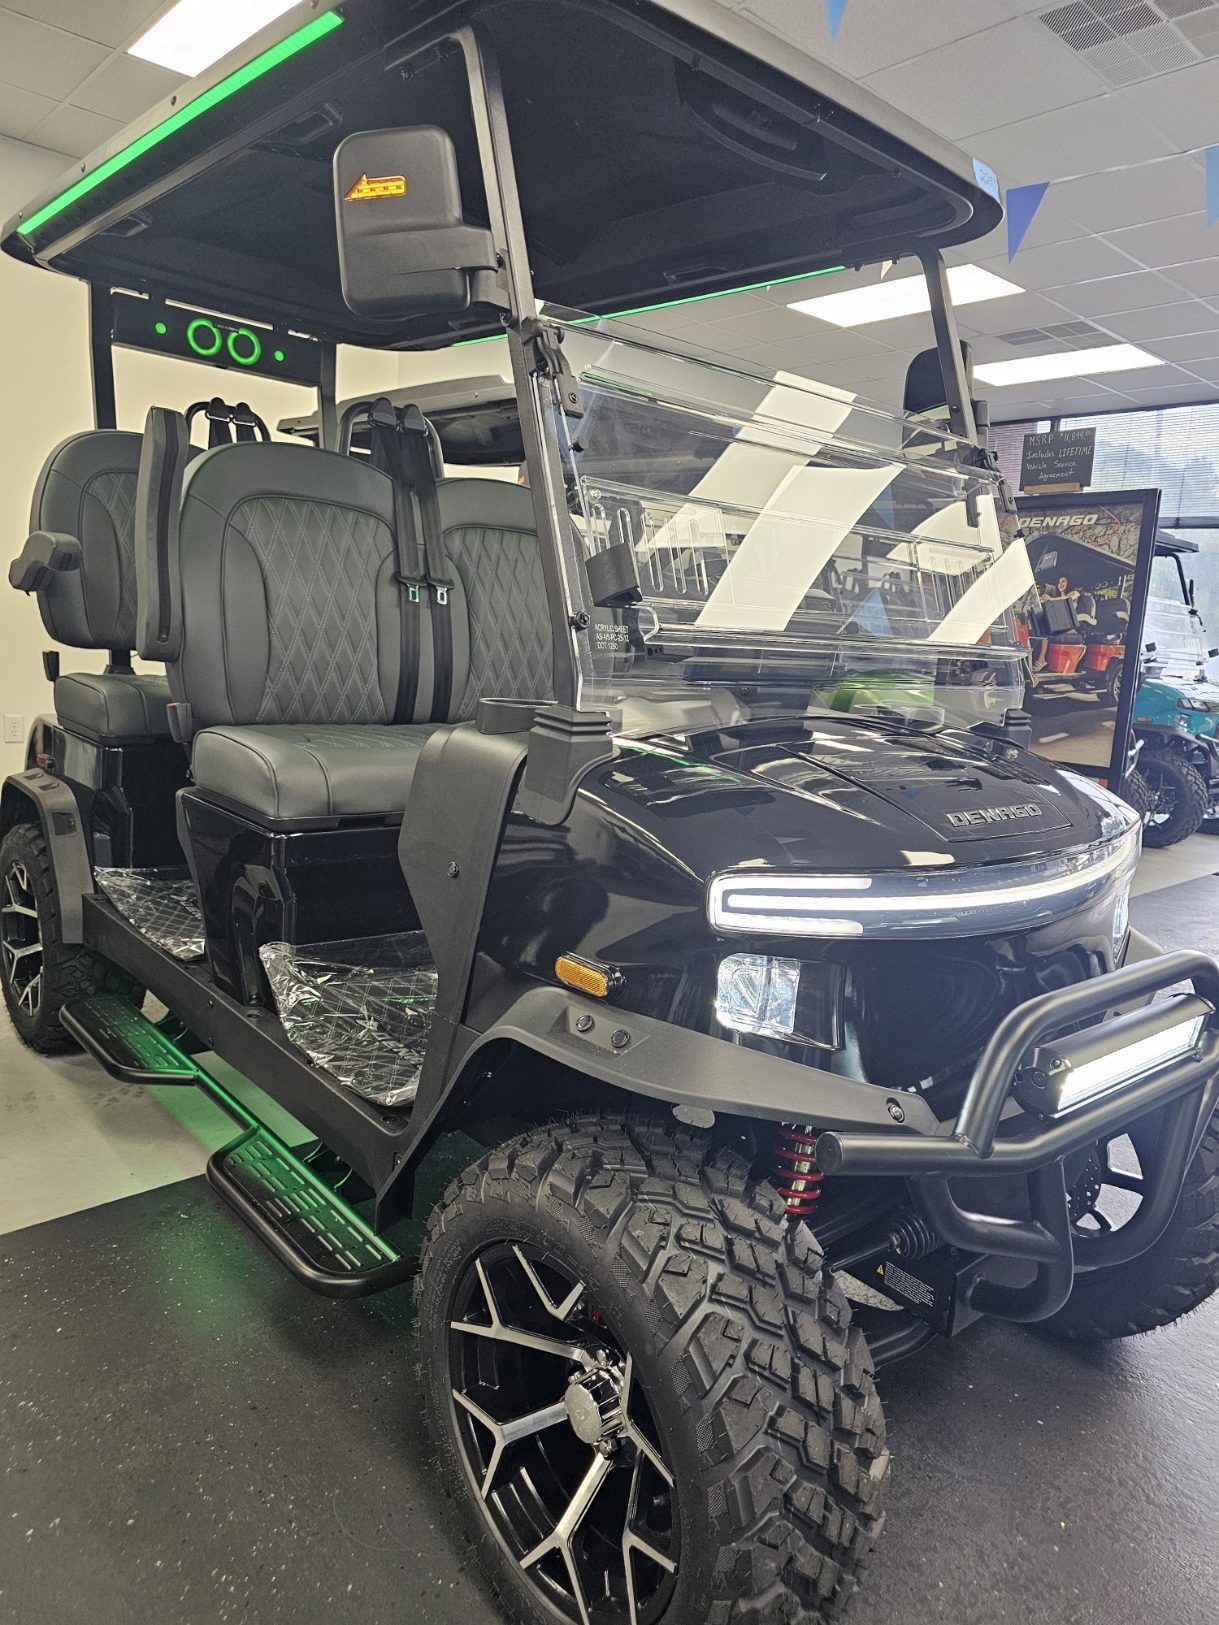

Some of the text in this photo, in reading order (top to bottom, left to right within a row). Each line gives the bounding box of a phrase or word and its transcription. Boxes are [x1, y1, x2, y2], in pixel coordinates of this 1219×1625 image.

[1029, 433, 1054, 446] MSRP
[1026, 445, 1093, 460] Includes LIFETIME
[1020, 514, 1099, 528] DENAGO
[946, 803, 1042, 828] DENAGO
